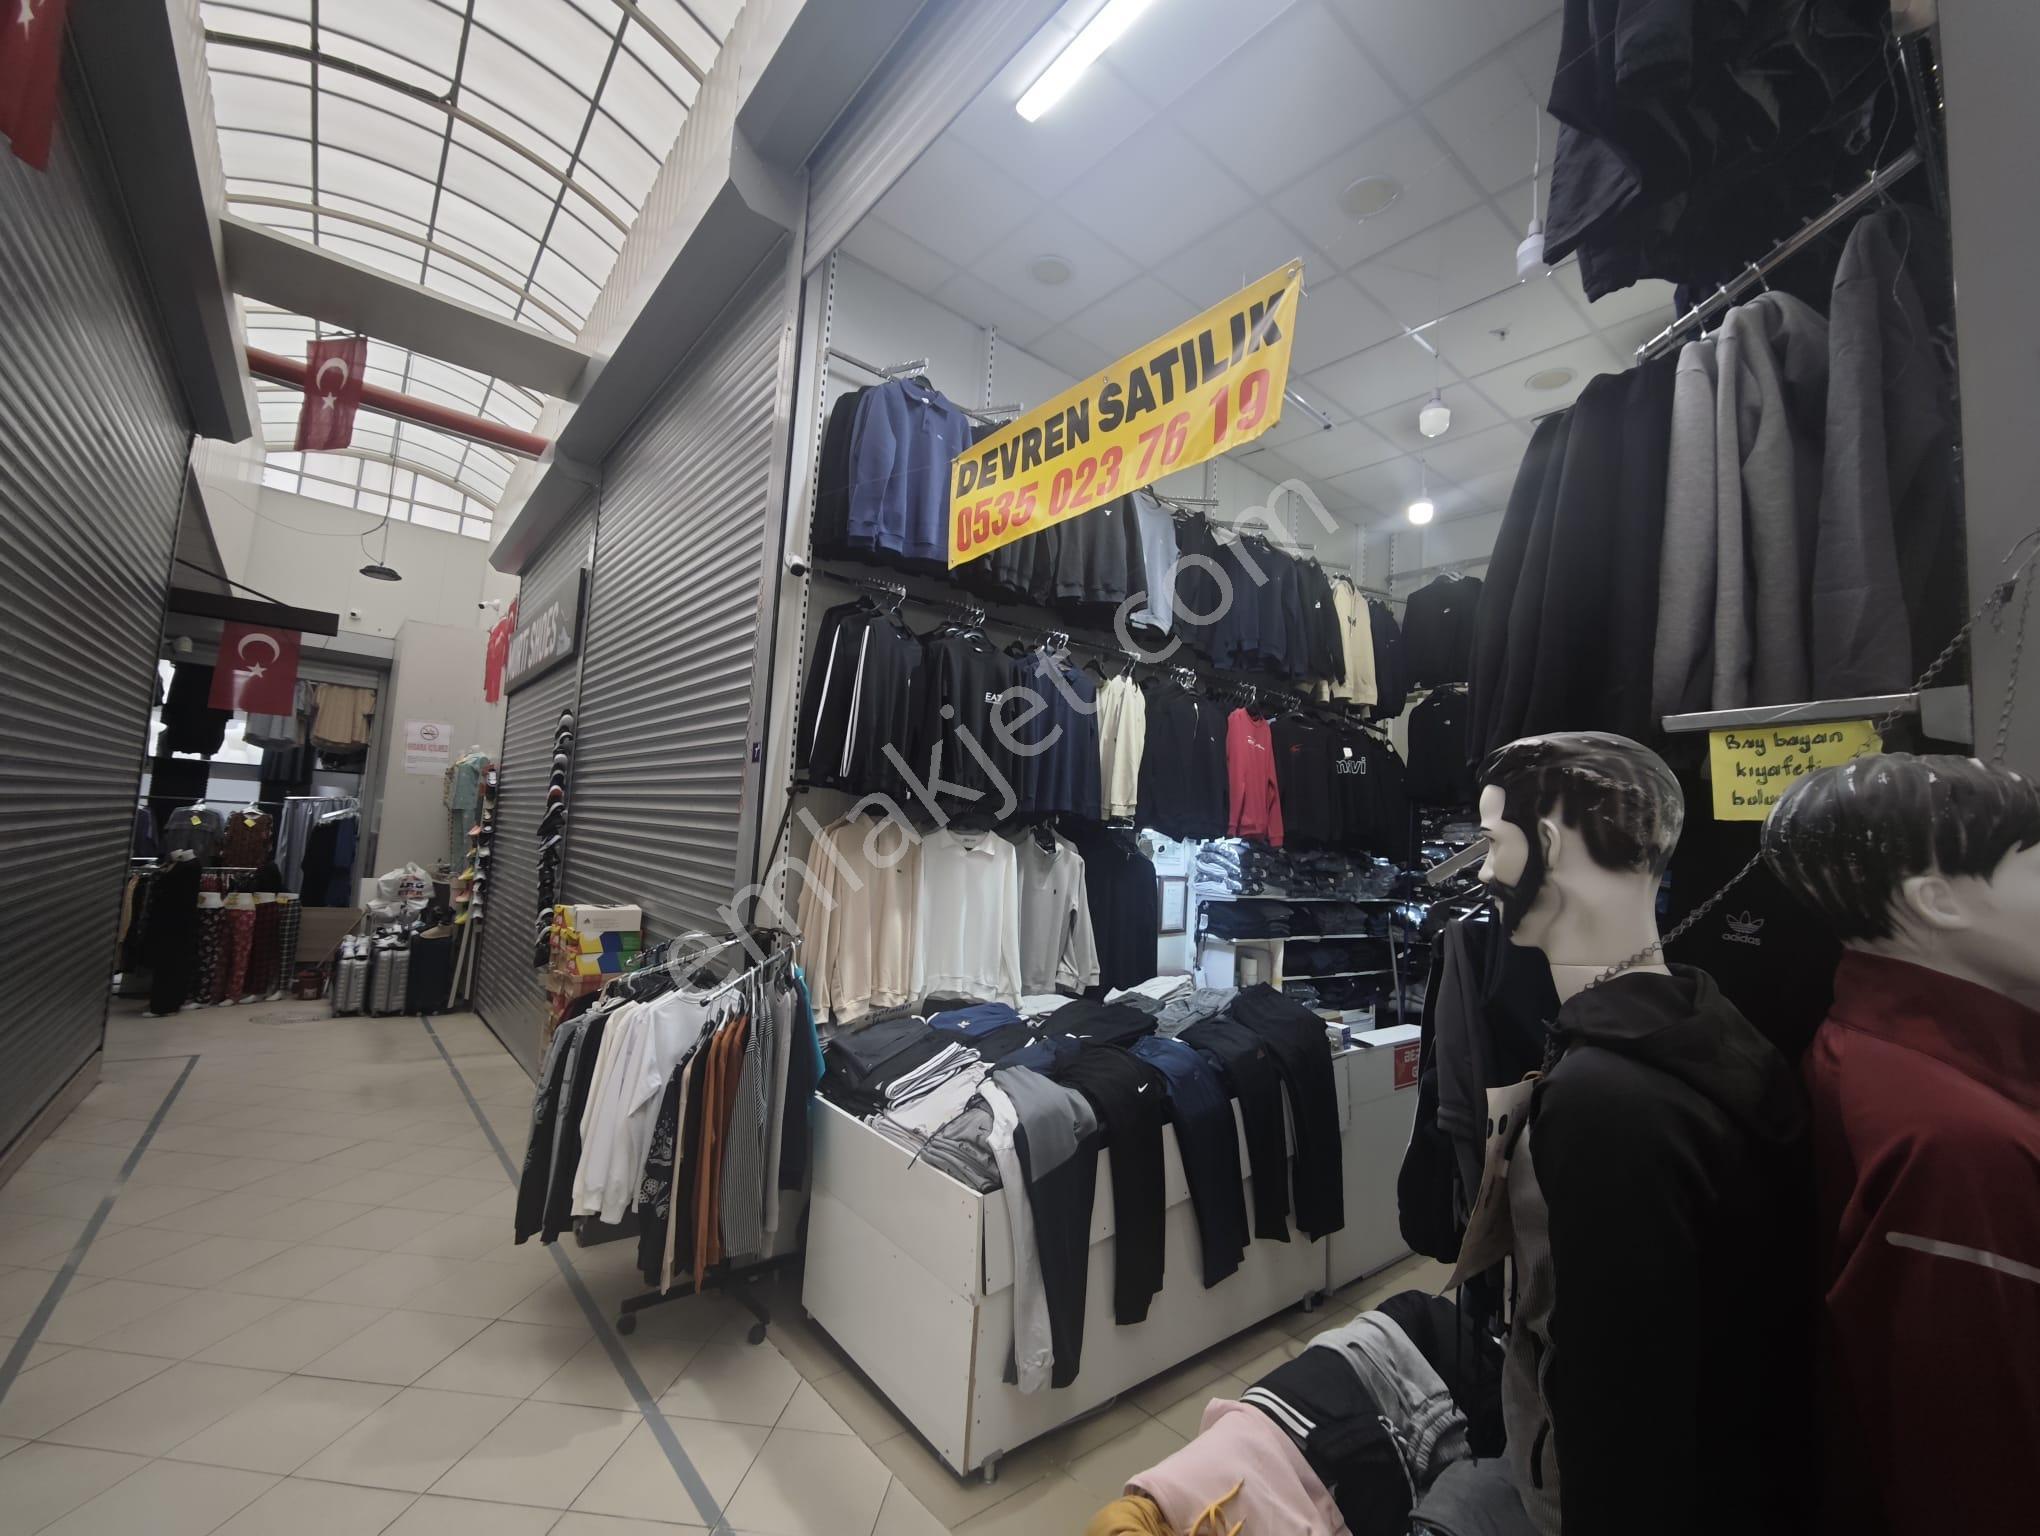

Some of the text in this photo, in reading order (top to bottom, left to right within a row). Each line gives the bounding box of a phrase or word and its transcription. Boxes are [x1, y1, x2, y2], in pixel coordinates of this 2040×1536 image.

[956, 289, 1286, 498] DEVREN SATILIK
[957, 368, 1270, 552] 0535 023 76 19
[985, 692, 1003, 702] EA7
[1773, 731, 1844, 753] bayan
[1721, 932, 1761, 946] adidas
